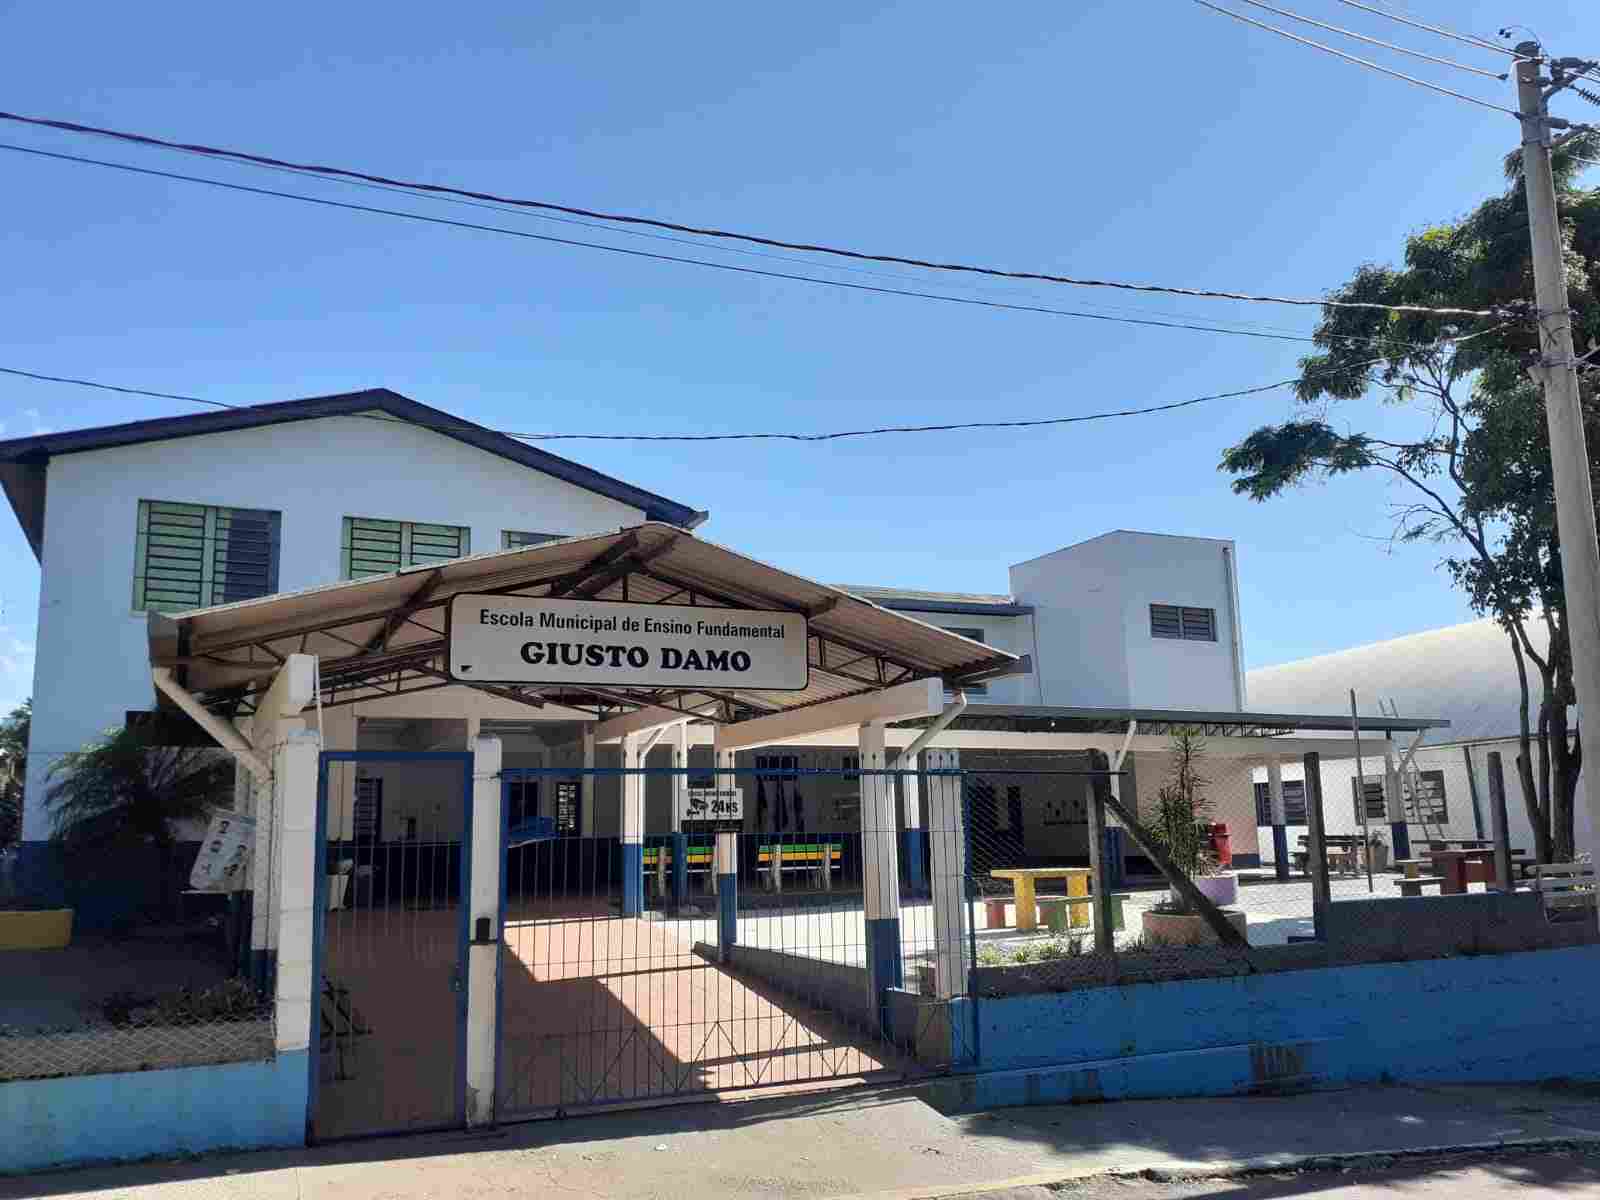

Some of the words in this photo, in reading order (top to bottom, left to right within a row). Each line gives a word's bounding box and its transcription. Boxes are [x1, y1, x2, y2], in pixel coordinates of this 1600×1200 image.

[480, 609, 534, 627] Escola
[540, 612, 617, 633] Municipal
[622, 616, 640, 632] de
[644, 617, 692, 634] Ensino
[697, 621, 785, 639] Fundamental
[520, 641, 649, 668] GIUSTO
[660, 647, 751, 672] DAMO
